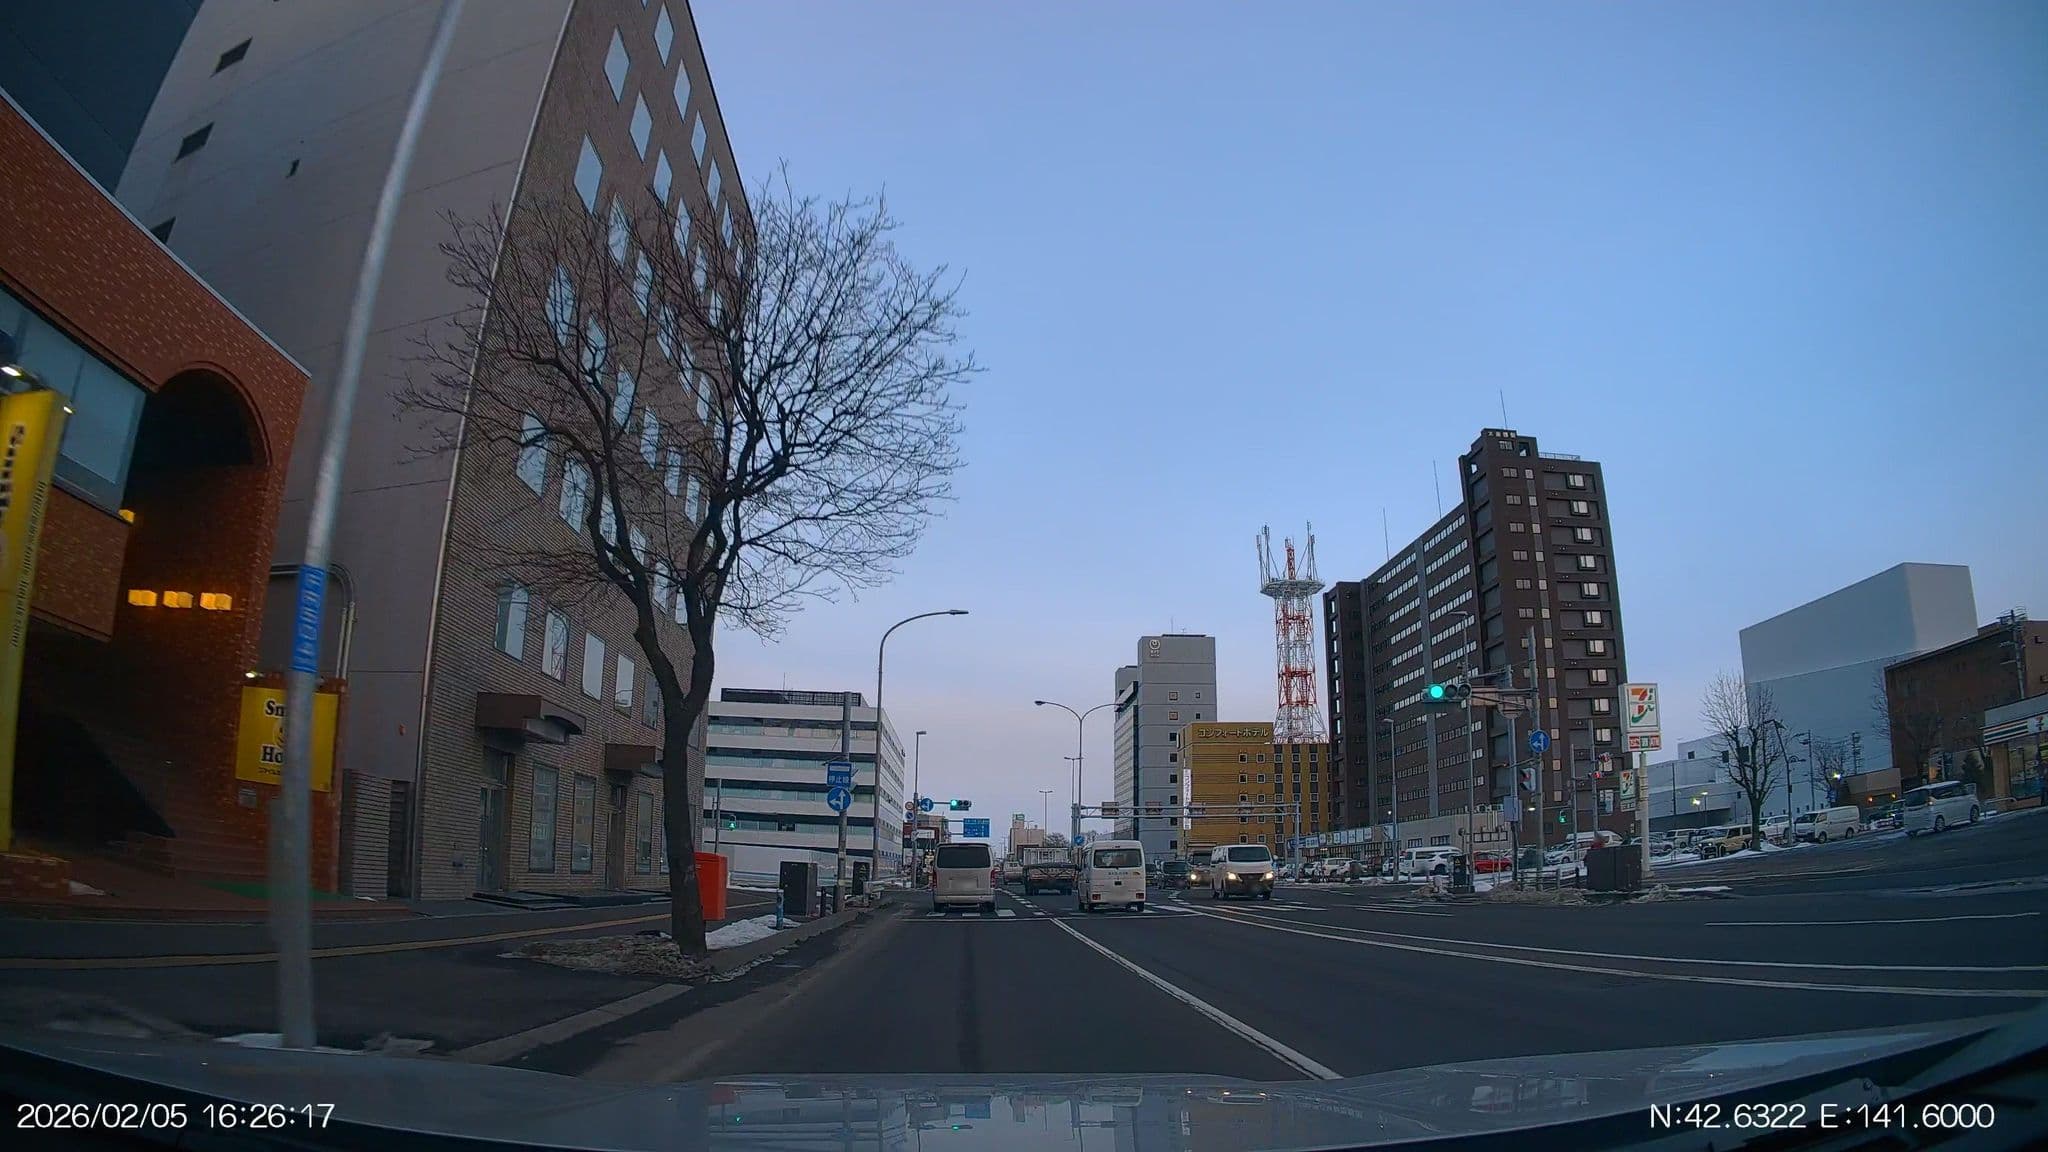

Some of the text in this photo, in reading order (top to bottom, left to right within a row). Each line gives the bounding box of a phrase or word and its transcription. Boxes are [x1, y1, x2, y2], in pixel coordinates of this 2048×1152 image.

[1198, 727, 1269, 737] コンフォートホテル
[829, 775, 849, 784] 停止線
